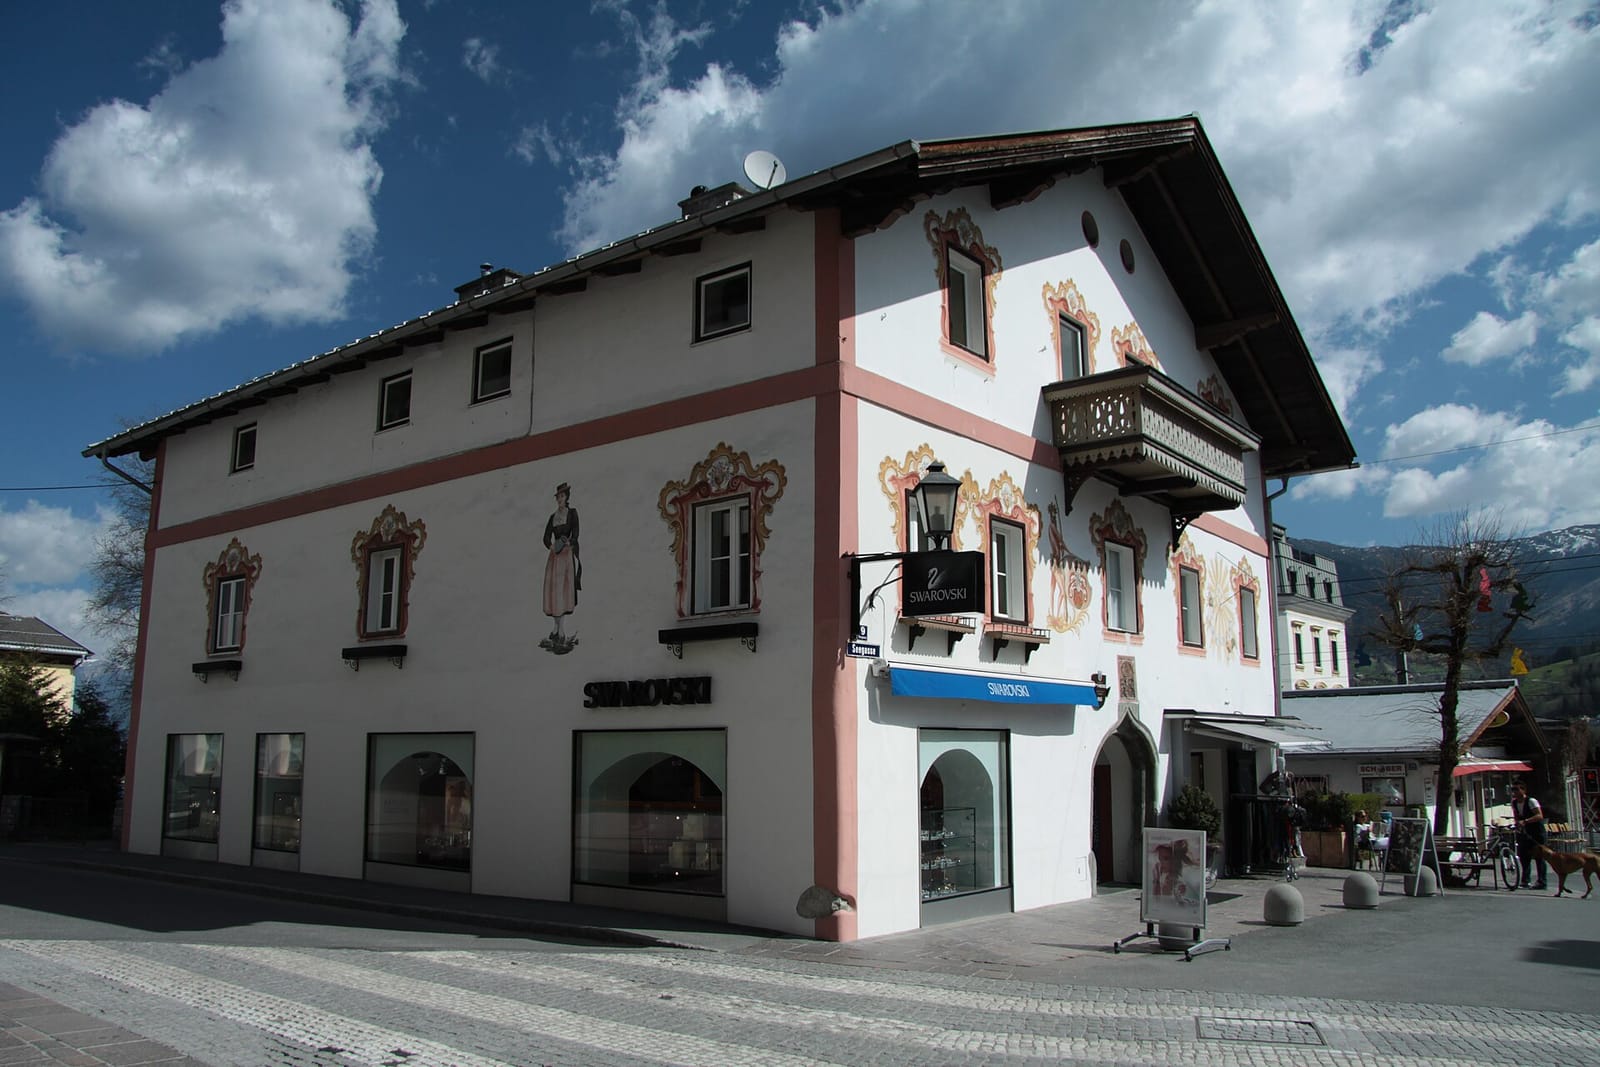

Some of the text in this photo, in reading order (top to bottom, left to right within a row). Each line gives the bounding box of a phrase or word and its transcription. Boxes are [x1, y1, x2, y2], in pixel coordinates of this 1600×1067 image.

[909, 587, 967, 604] SWAROVSKI
[860, 626, 866, 636] 9
[584, 676, 712, 708] SWAROVSKI
[987, 682, 1030, 697] SWAROVSKI
